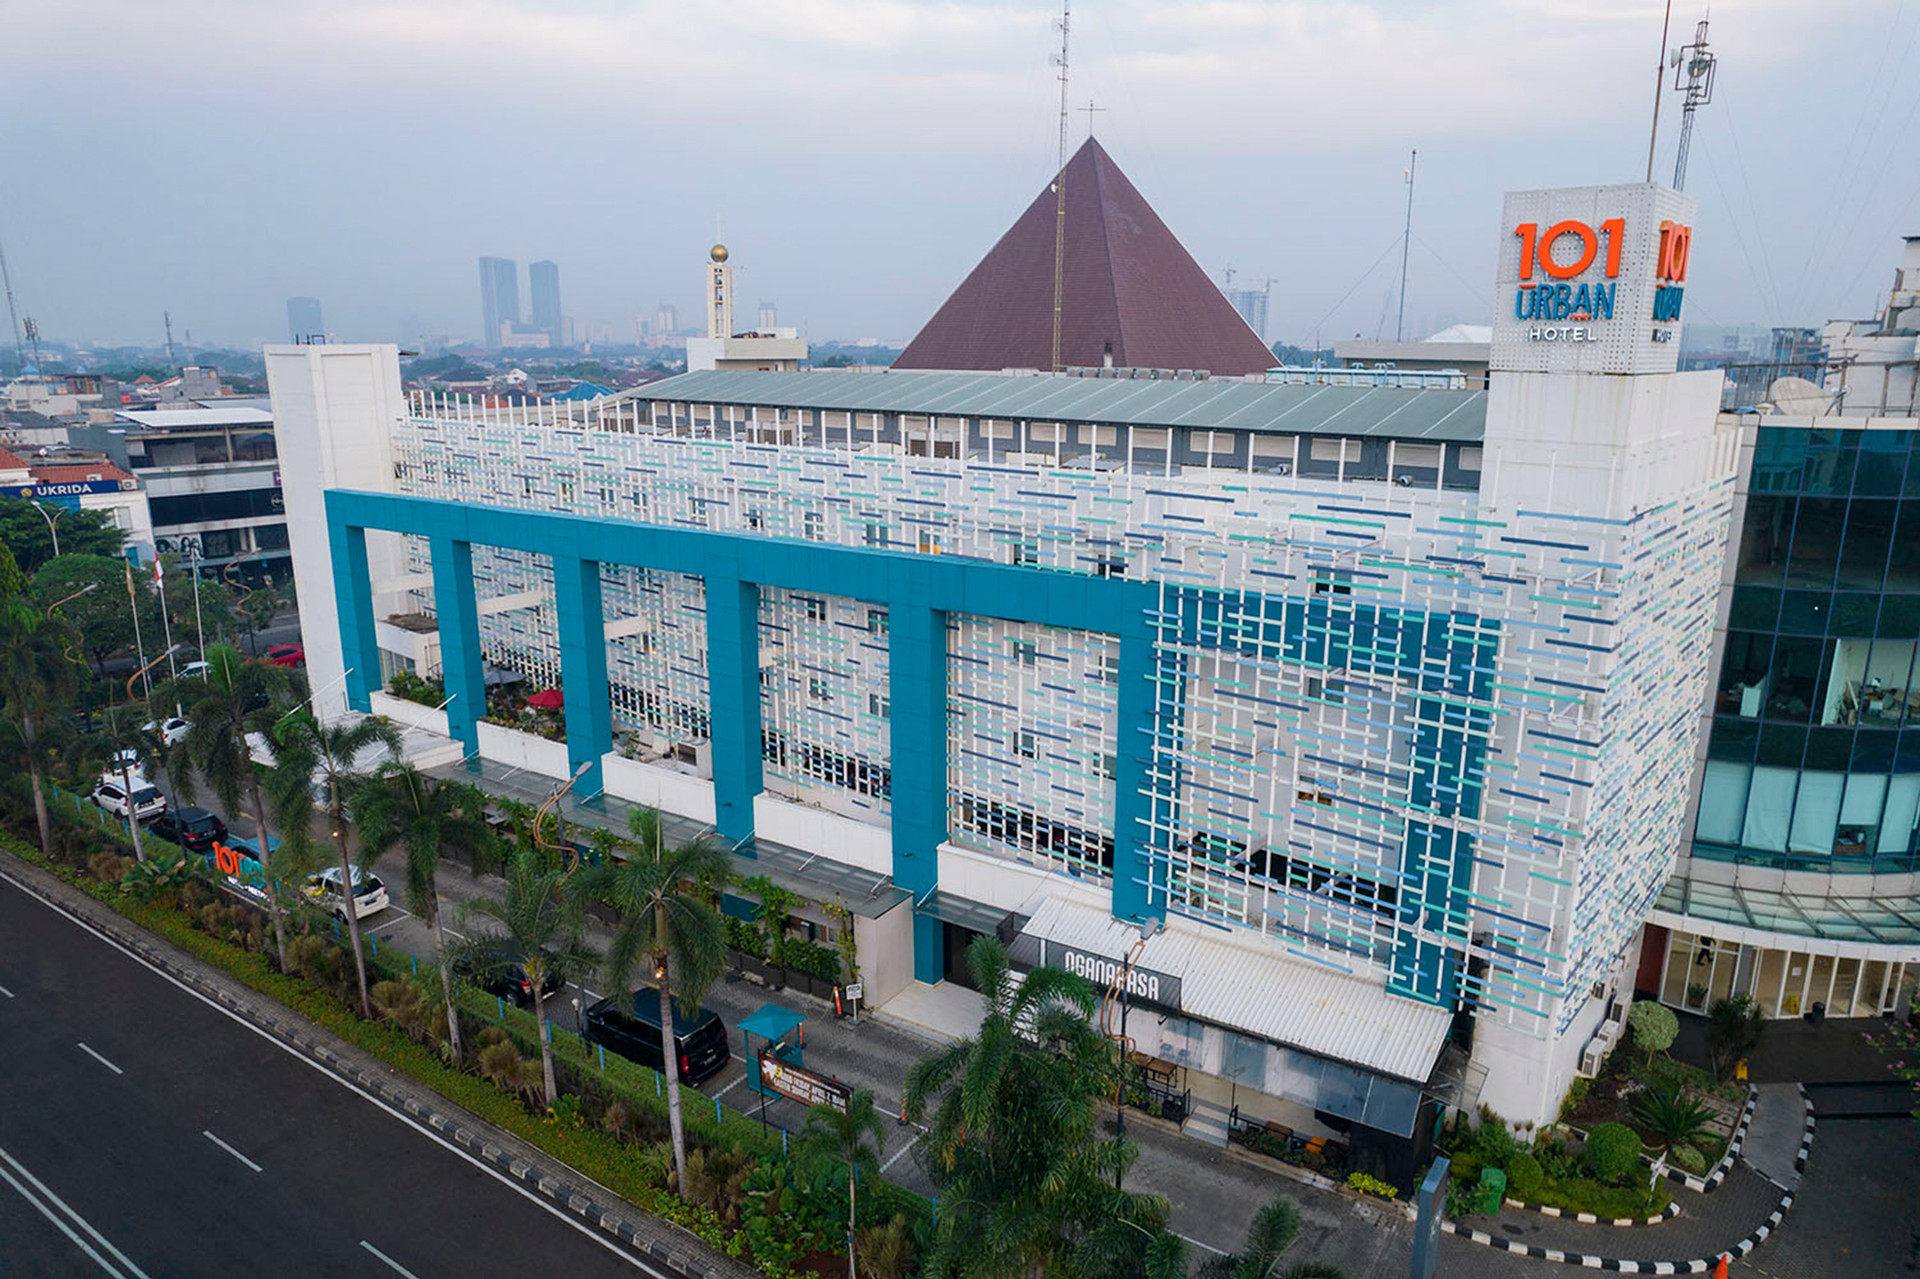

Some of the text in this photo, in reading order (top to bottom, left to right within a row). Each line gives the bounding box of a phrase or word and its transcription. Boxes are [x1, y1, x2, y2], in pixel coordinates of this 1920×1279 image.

[1513, 218, 1626, 280] 101
[1656, 220, 1692, 282] 101
[1516, 283, 1617, 320] URBAN
[1529, 327, 1598, 341] HOTEL
[36, 484, 93, 497] UKRIDA
